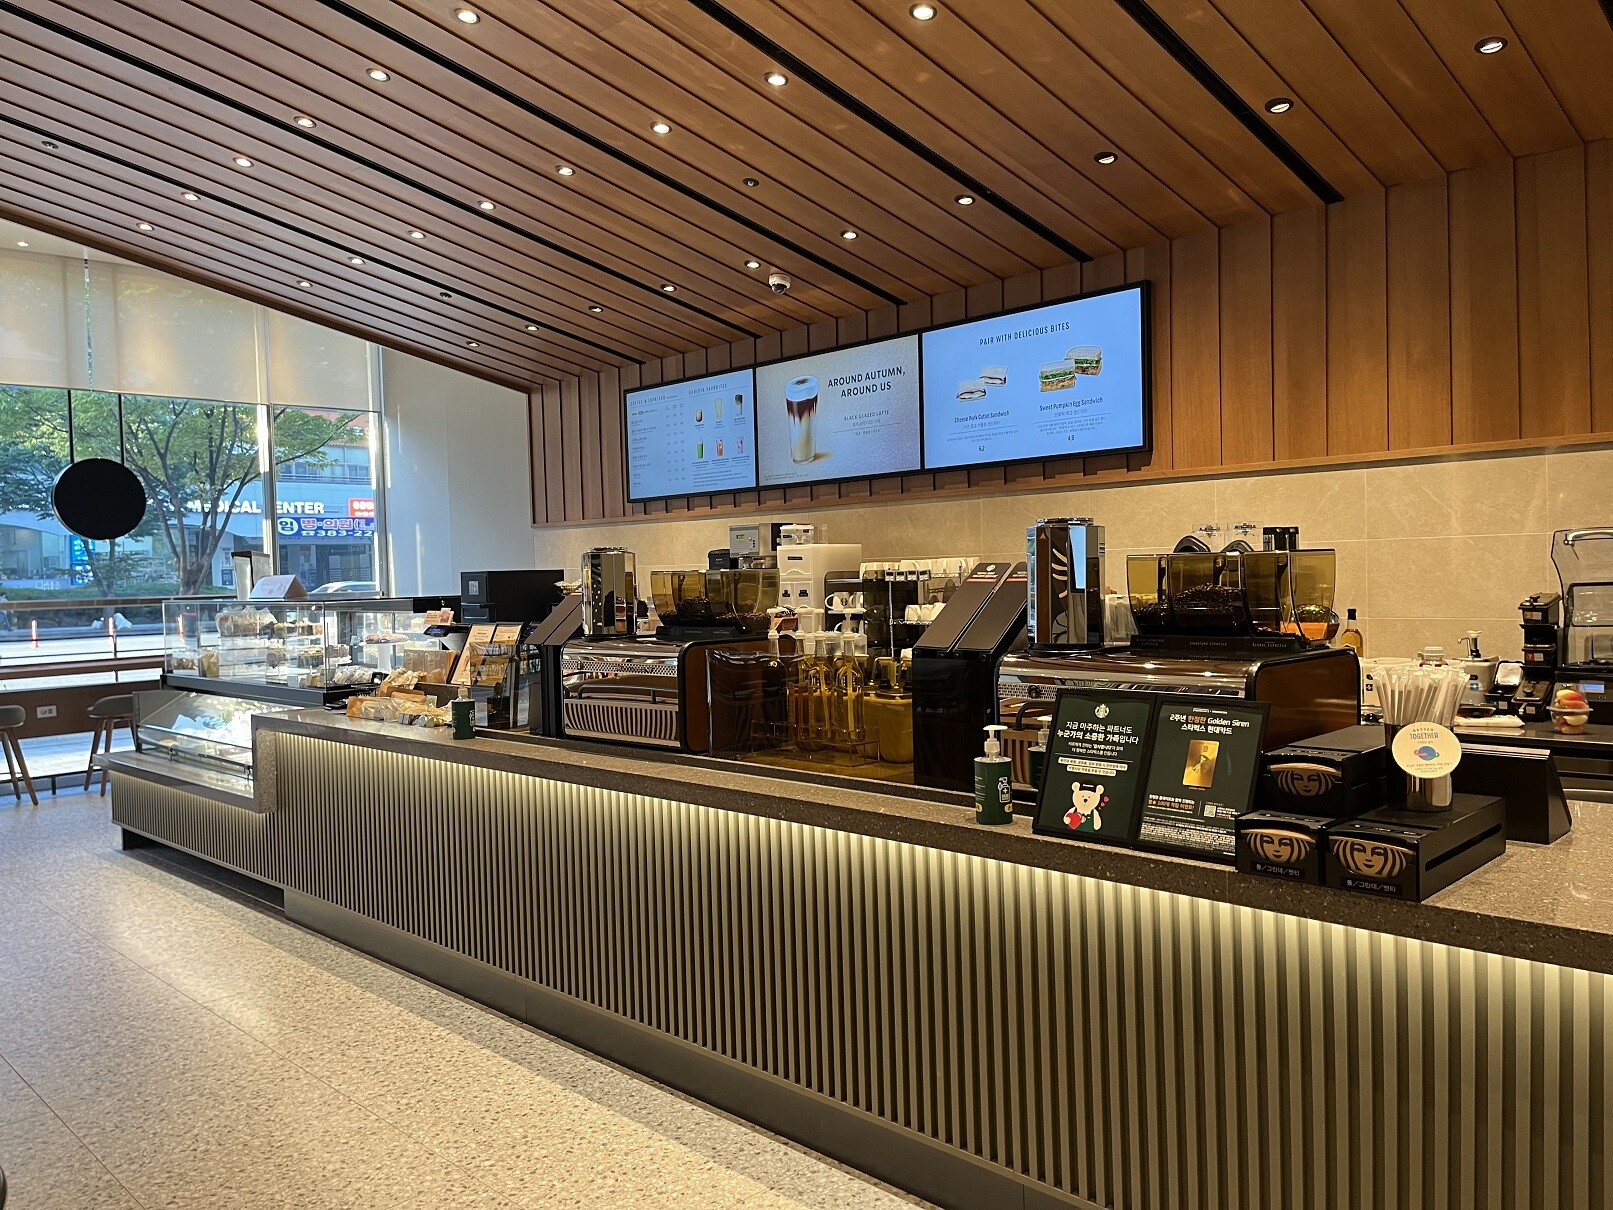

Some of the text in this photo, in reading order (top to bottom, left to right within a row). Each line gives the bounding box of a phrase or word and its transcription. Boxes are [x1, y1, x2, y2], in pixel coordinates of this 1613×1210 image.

[979, 322, 1070, 346] PAIR WITH DELICIOUS BITES
[828, 366, 906, 388] AROUND AUTUMN,
[841, 381, 892, 398] AROUND US
[1040, 396, 1104, 412] Sweet Pumpkin Egg Sandwich
[990, 410, 1010, 419] Sandwich
[276, 501, 325, 514] ENTER
[1065, 721, 1133, 734] 지금 마주하는 파트너도
[1169, 713, 1187, 723] 2주년
[1207, 717, 1231, 726] Golden
[1231, 719, 1250, 728] Siren
[1181, 723, 1233, 735] 스타벅스 현대카드
[1409, 732, 1439, 740] TOGETHER
[1057, 729, 1139, 745] 누군가의 소중한 가족입니다
